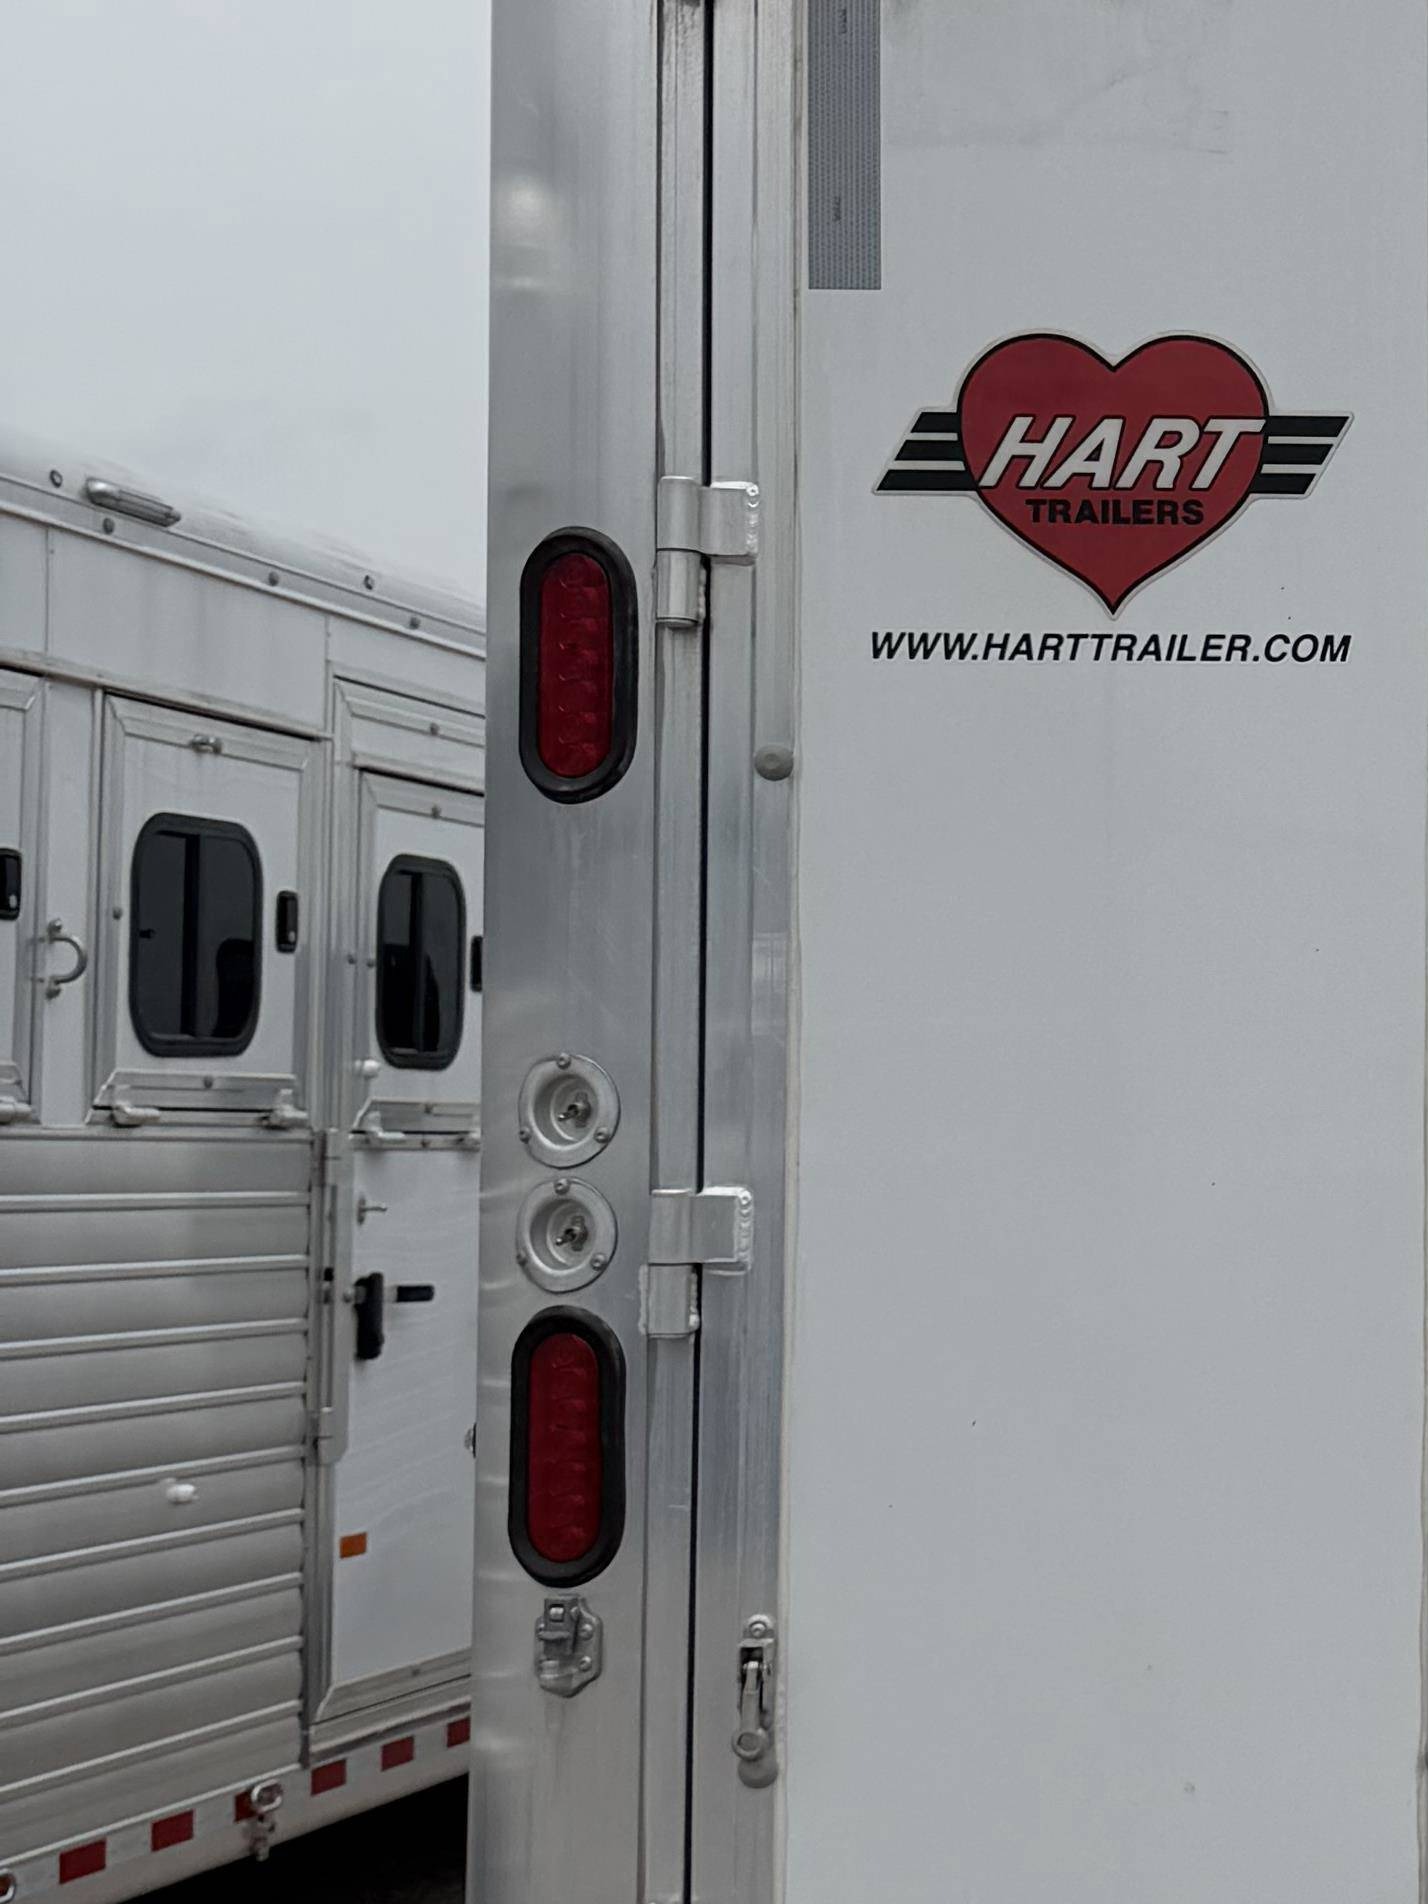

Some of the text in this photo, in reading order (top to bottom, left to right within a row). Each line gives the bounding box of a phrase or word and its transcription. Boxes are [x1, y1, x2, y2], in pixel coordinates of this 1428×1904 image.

[977, 414, 1267, 490] HART
[1025, 498, 1205, 526] TRAILERS
[871, 631, 1352, 663] WWW.HARTTRAILER.COM
